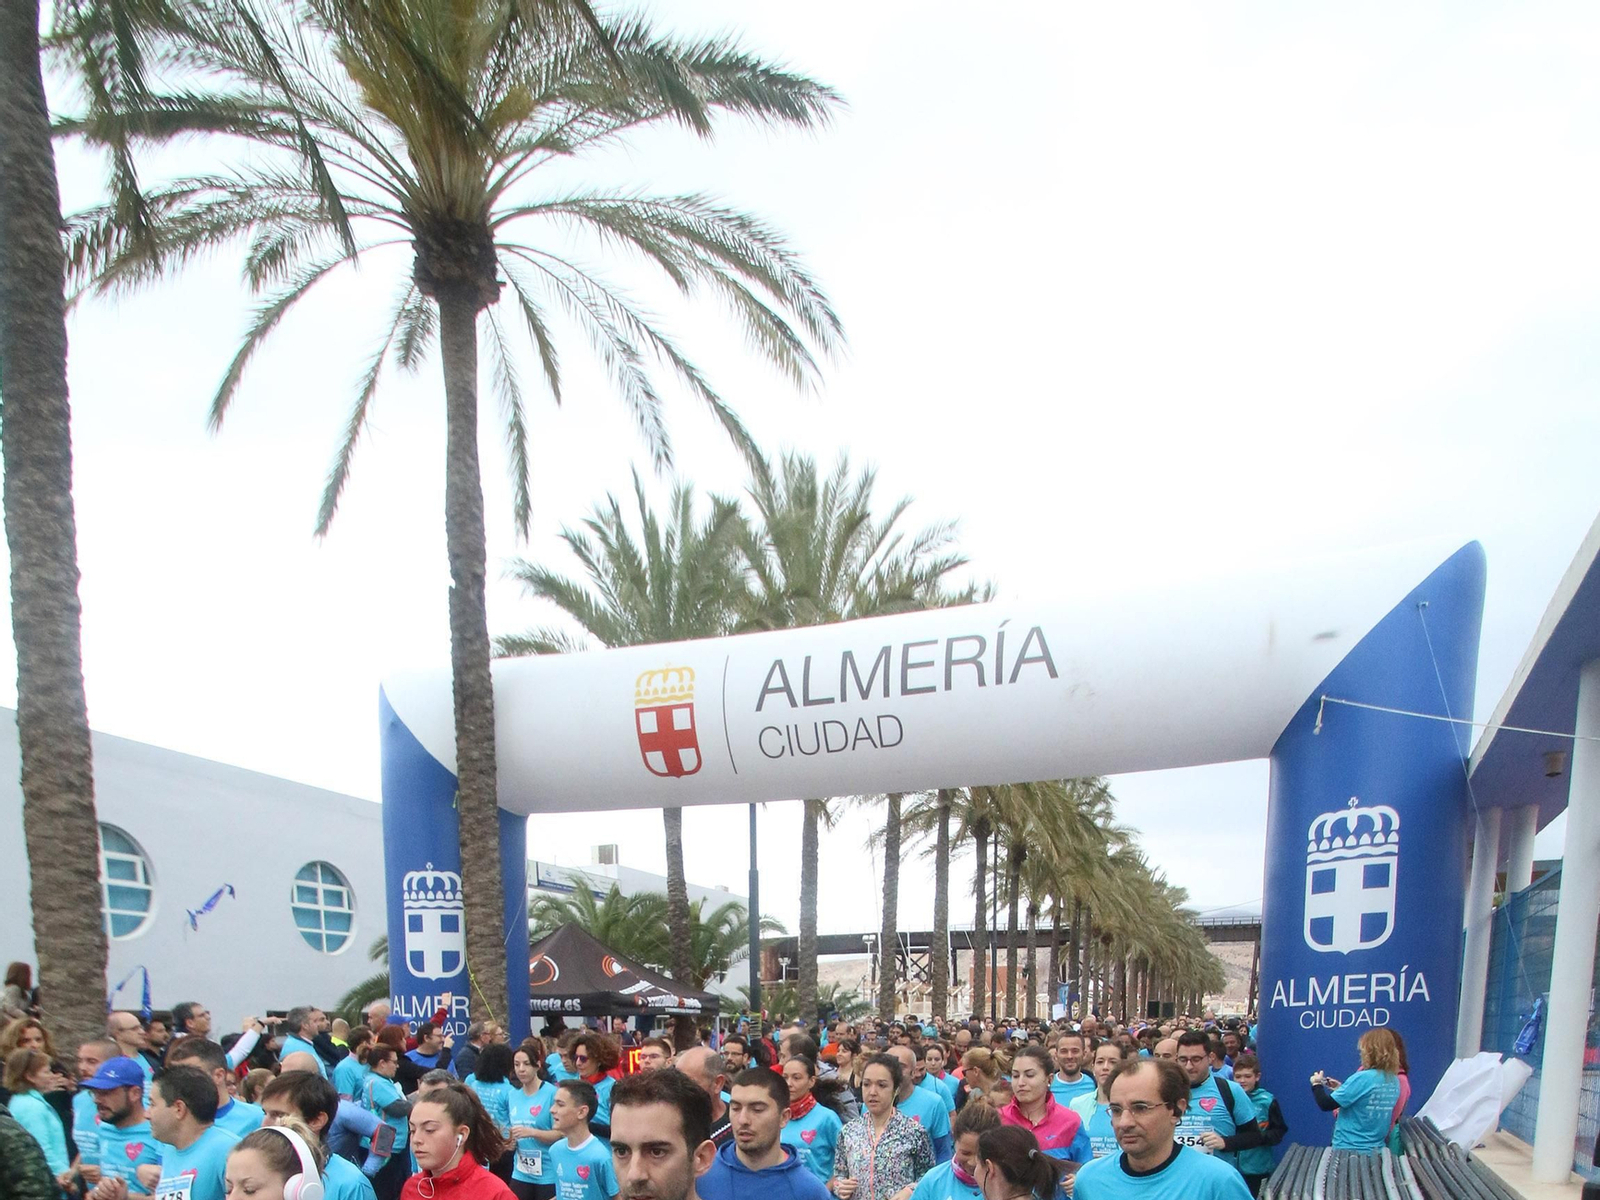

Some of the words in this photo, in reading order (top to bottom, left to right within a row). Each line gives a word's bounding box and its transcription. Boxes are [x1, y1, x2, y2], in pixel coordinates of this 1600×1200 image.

[755, 619, 1059, 712] ALMERÍA
[758, 714, 904, 759] CIUDAD
[529, 998, 582, 1012] meta.es
[1270, 964, 1430, 1009] ALMERÍA
[1299, 1007, 1390, 1029] CIUDAD
